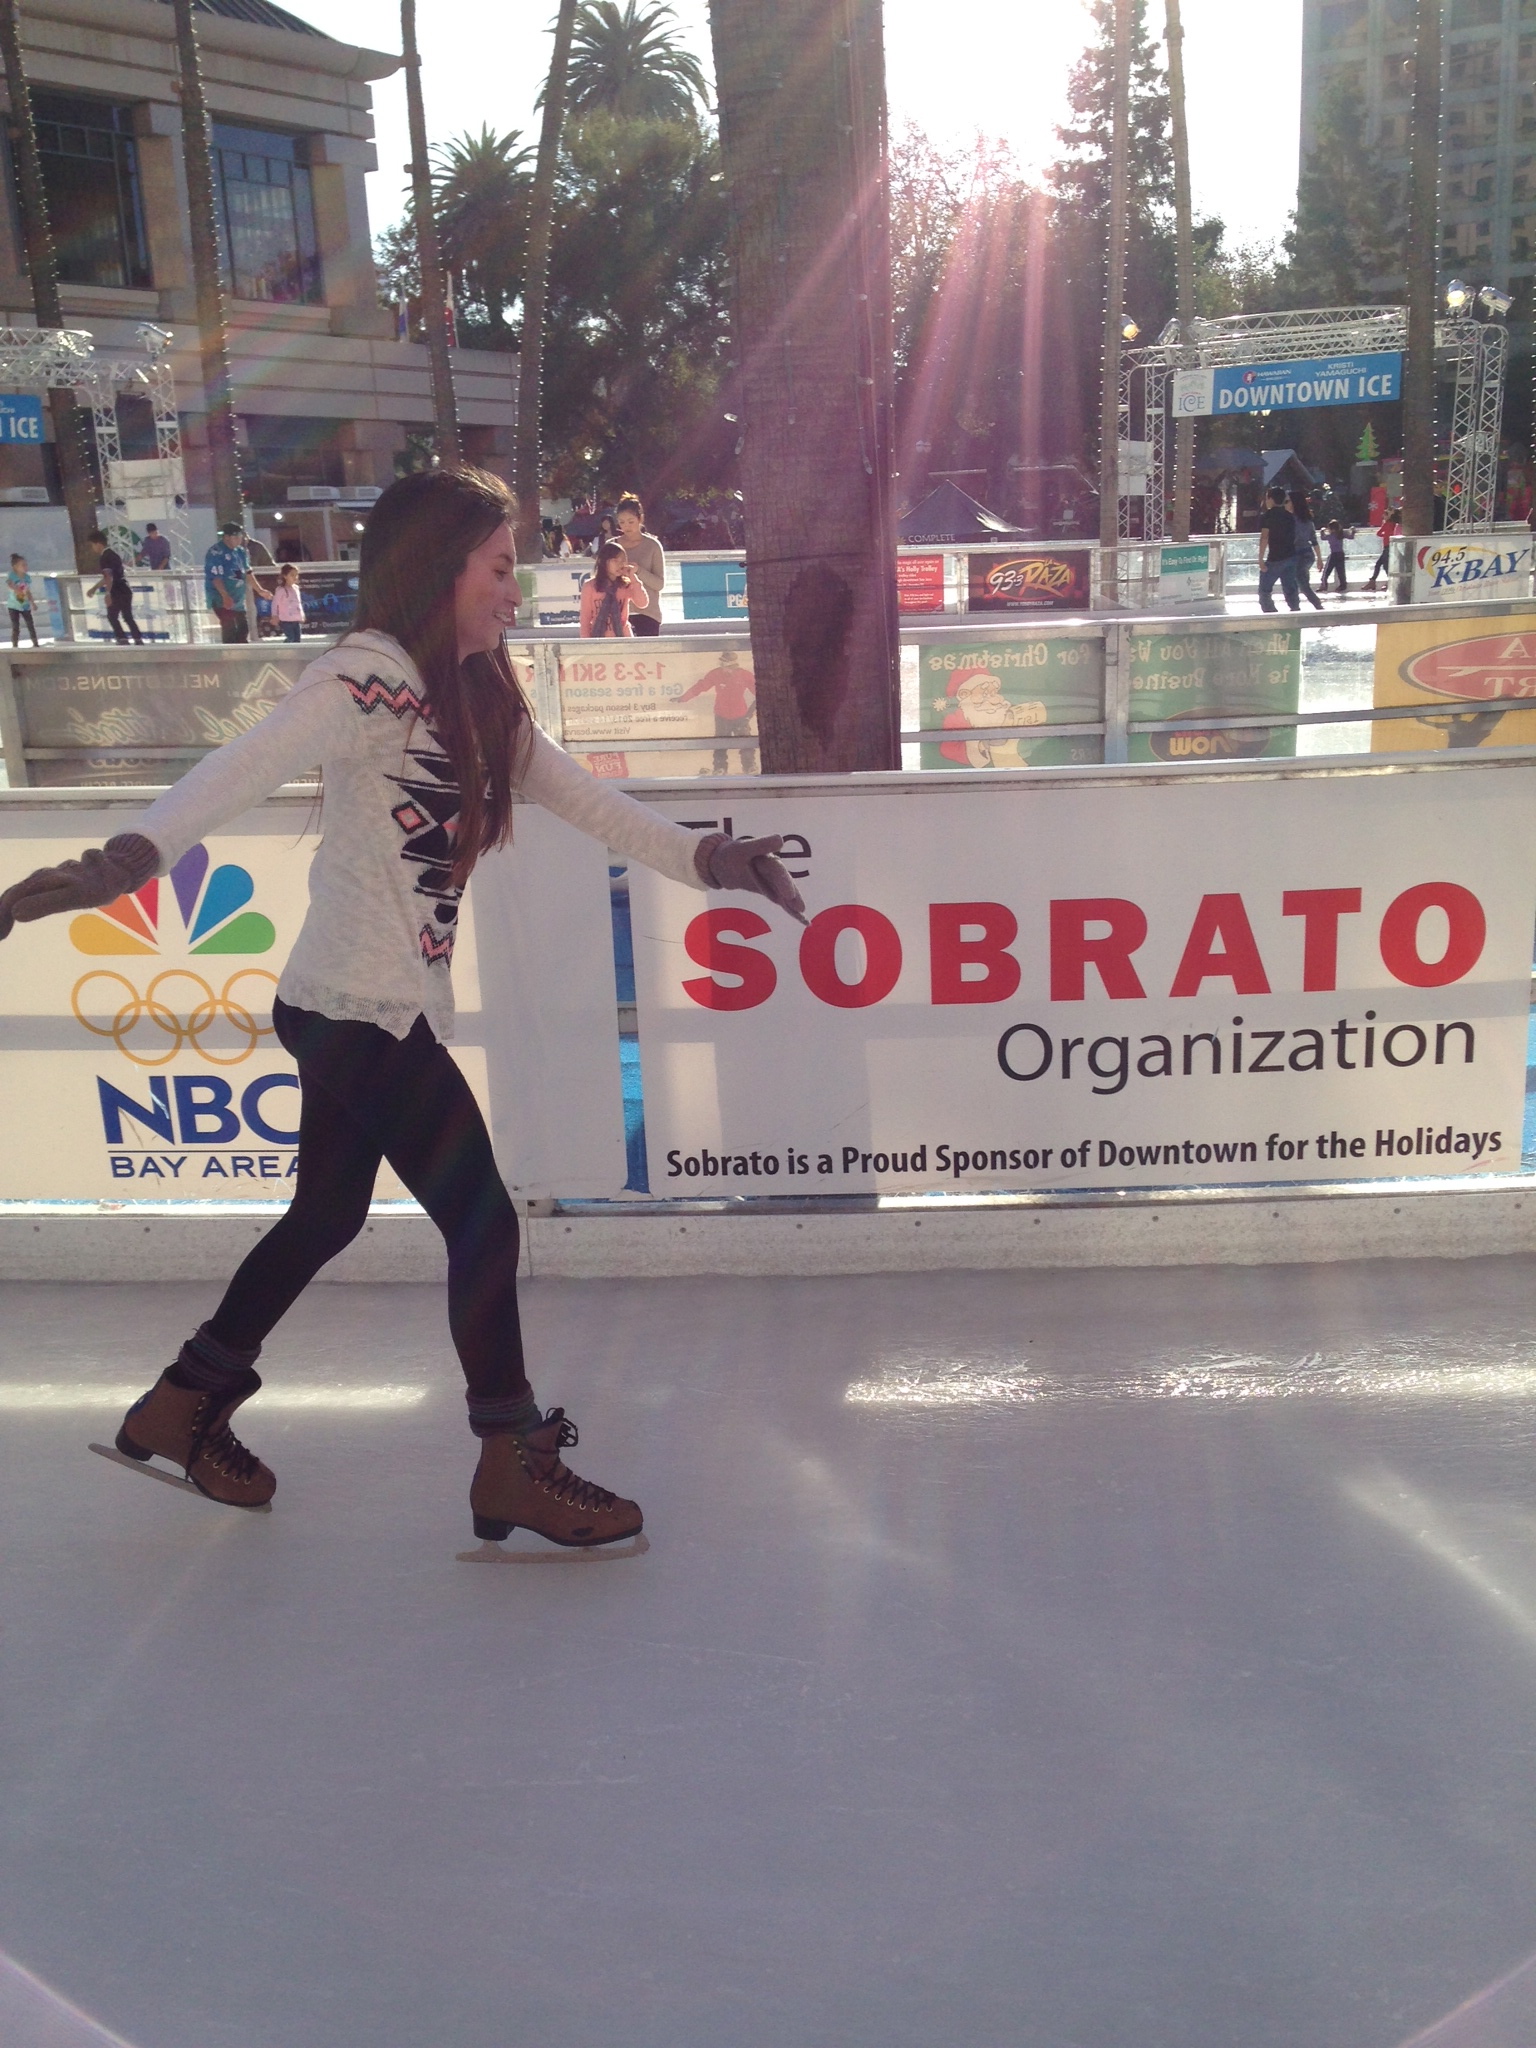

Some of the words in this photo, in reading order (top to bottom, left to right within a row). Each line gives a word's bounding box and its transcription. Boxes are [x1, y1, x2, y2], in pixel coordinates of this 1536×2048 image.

[1315, 367, 1367, 377] YAMAGUCHI
[1327, 361, 1354, 370] KRISTI
[1219, 377, 1349, 409] DOWNTOWN
[1358, 374, 1393, 398] ICE
[10, 416, 39, 438] ICE
[908, 533, 956, 544] COMPLETE
[1431, 546, 1468, 567] 94.5
[1017, 560, 1073, 598] RAZA
[728, 593, 749, 607] PG&
[681, 881, 1488, 1012] SOBRATO
[996, 1009, 1475, 1096] Organization
[96, 1073, 300, 1146] NBC
[668, 1149, 780, 1178] Sobrato
[788, 1147, 810, 1175] is
[817, 1153, 833, 1174] a
[841, 1144, 928, 1174] Proud
[936, 1144, 1055, 1178] Sponsor
[1060, 1140, 1091, 1168] of
[1098, 1139, 1257, 1168] Downtown
[1266, 1132, 1308, 1161] for
[1316, 1130, 1365, 1160] the
[1374, 1125, 1502, 1160] Holidays
[110, 1156, 188, 1179] BAY
